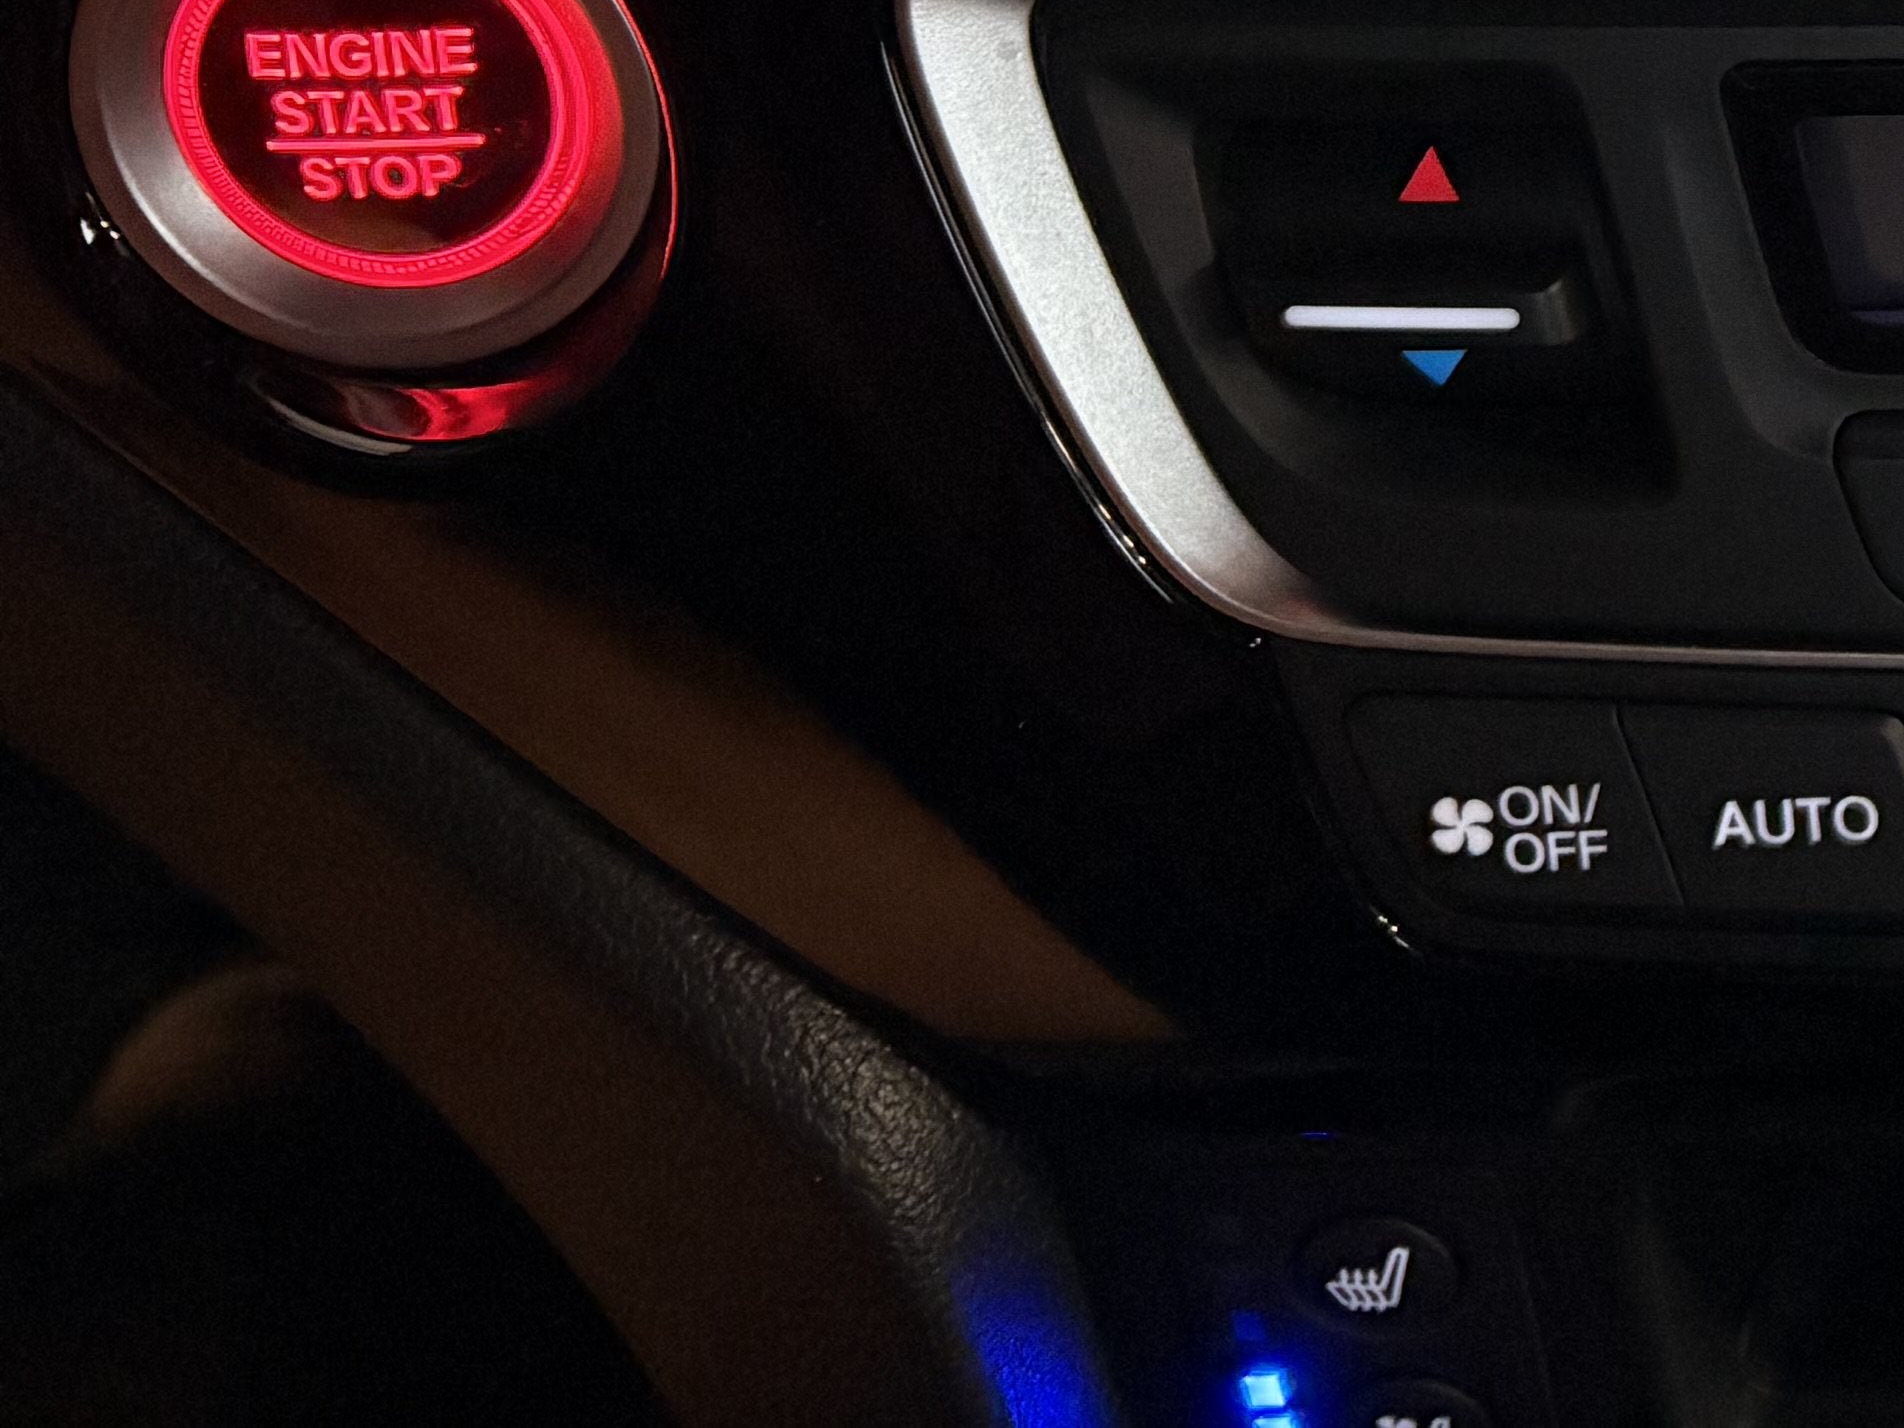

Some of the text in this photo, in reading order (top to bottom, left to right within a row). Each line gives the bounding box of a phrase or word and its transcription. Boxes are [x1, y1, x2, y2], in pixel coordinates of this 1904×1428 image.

[244, 26, 479, 81] ENGINE
[270, 86, 465, 135] START
[298, 153, 464, 202] STOP
[1496, 781, 1603, 829] ON/
[1712, 793, 1881, 848] AUTO
[1502, 827, 1610, 875] OFF
